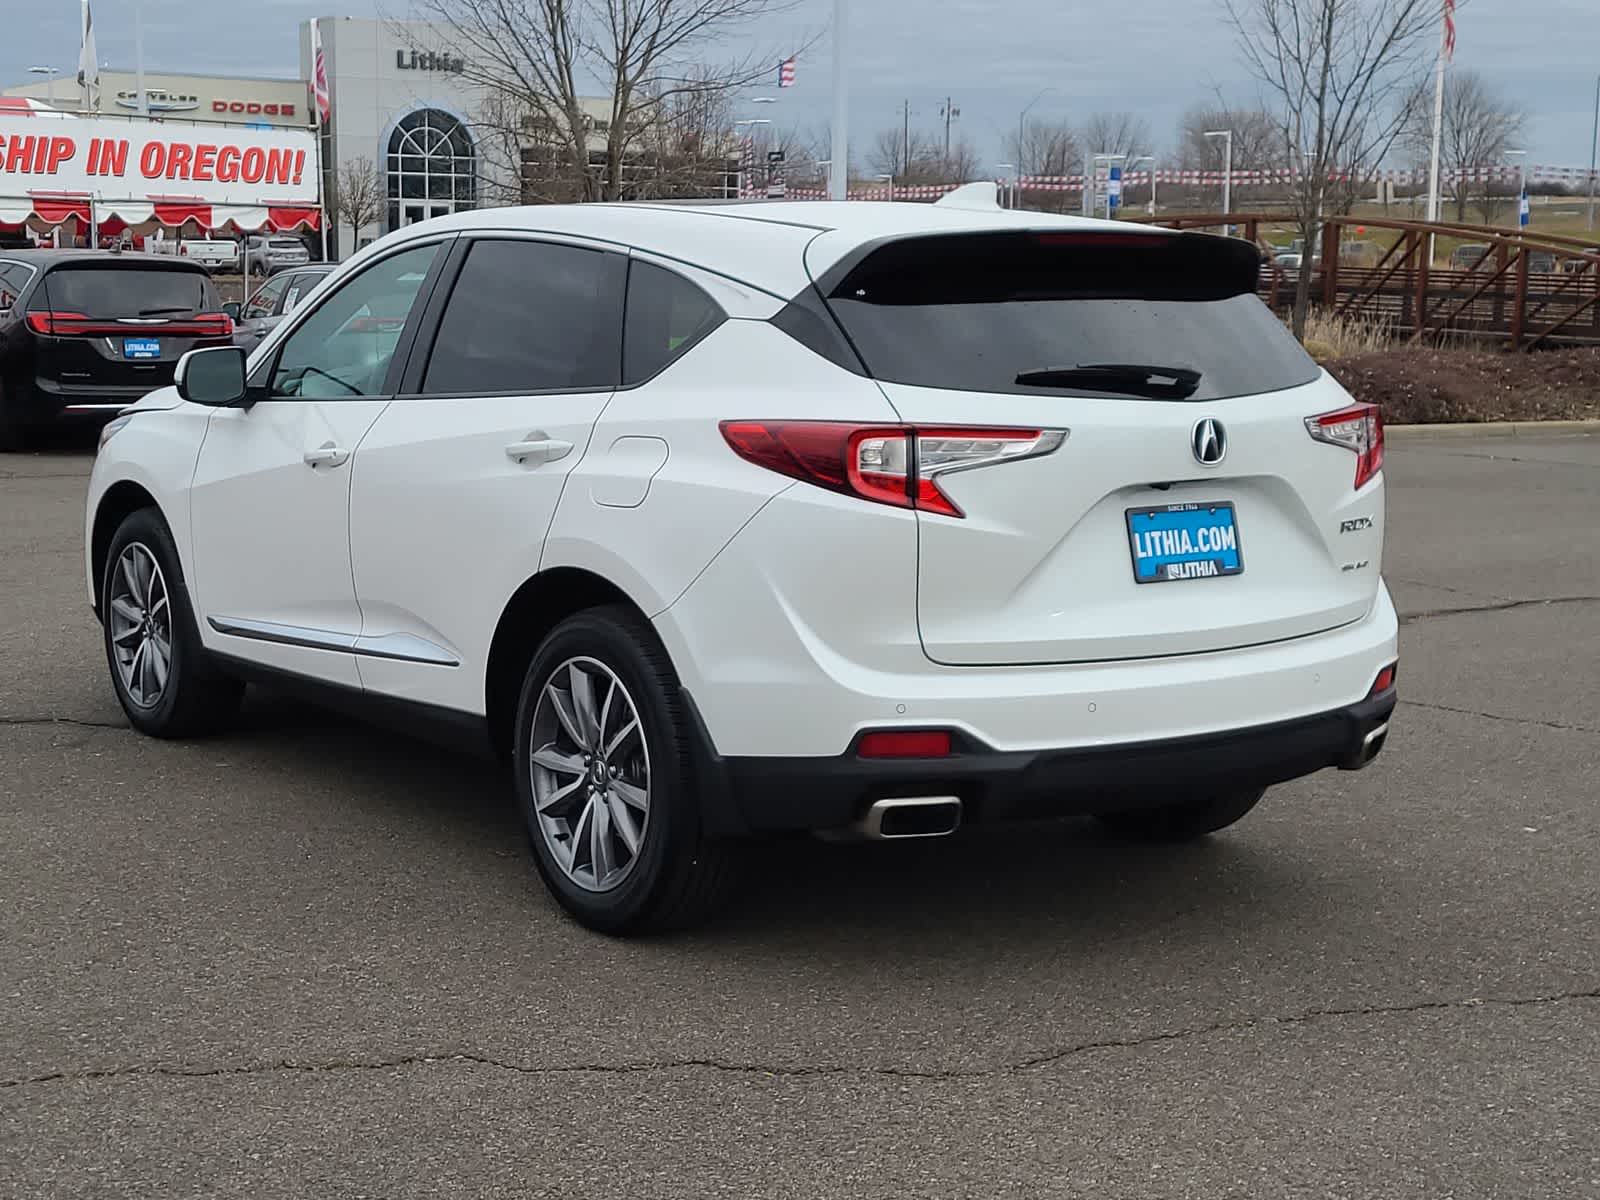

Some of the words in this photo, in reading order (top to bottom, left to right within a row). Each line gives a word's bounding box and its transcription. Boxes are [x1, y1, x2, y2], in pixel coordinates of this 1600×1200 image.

[397, 50, 463, 71] Lithia
[117, 91, 198, 102] CHYSLER
[212, 101, 295, 116] DODGE
[86, 138, 129, 177] IN
[140, 141, 306, 185] OREGON!
[1340, 514, 1374, 534] RDX
[1135, 525, 1236, 558] LITHIA.COM
[1180, 561, 1218, 578] LITHIA
